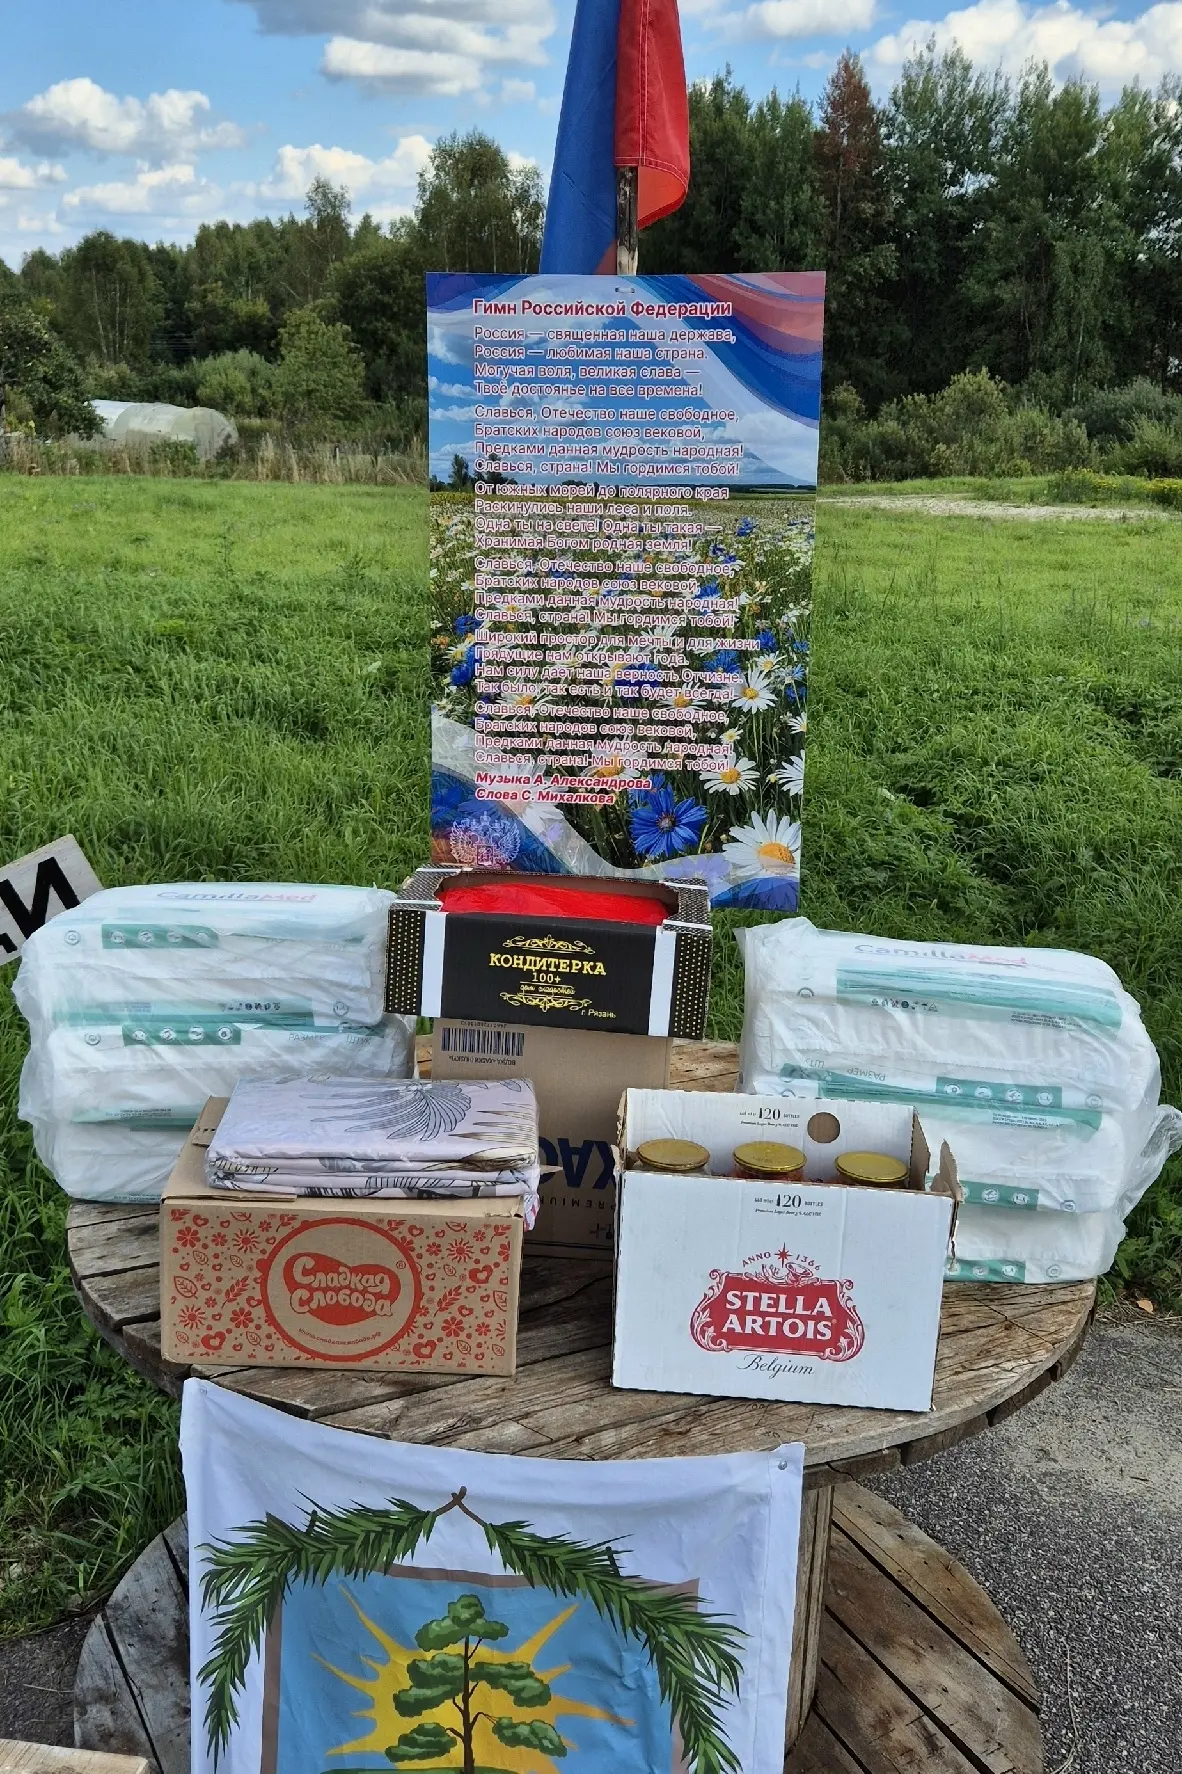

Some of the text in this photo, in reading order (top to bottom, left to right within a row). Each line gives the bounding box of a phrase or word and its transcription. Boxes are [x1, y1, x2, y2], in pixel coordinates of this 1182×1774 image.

[474, 300, 731, 318] Гимн Российской Федерации
[475, 327, 736, 342] Россия священная наша держава,
[475, 345, 707, 361] Россия любимая наша страна.
[475, 364, 680, 379] Могучая воля, великая слава
[476, 380, 702, 399] Твоё достоянье на все времена!
[476, 405, 739, 422] Славься, Отечество наше свободное,
[476, 424, 705, 440] Братских народов союз вековой,
[476, 442, 743, 459] Предками данная мудрость народная!
[476, 460, 739, 476] Славься, страна! Мы гордимся тобой!
[476, 482, 728, 499] От южных морей до полярного края
[476, 499, 692, 516] Раскинулись наши леса и поля.
[476, 518, 703, 533] Одна ты на свете! Одна ты такая
[477, 535, 692, 551] Хранимая Богом родная земля!
[476, 557, 734, 577] Славься, Отечество наше свободное,
[476, 575, 538, 588] Братских
[541, 578, 598, 590] народов
[602, 580, 637, 589] союз
[476, 592, 738, 611] Предками данная мудрость народная!
[476, 609, 734, 627] Славься, страна! Мы гордимся тобой!
[476, 630, 760, 649] Широкий простор для мечты и для жизни
[476, 647, 689, 666] Грядущие нам открывают года.
[476, 665, 504, 676] Нам
[507, 667, 538, 679] силу
[578, 668, 611, 679] наша
[616, 670, 678, 682] верность
[682, 671, 743, 682] Отчизне.
[476, 680, 499, 692] Так
[544, 683, 565, 693] так
[569, 685, 599, 694] есть
[604, 686, 612, 695] и
[617, 686, 638, 697] так
[641, 686, 680, 699] будет
[685, 688, 734, 699] всегда!
[476, 702, 730, 724] Славься, Отечество наше свободное,
[476, 718, 697, 739] Братских народов союз вековой,
[476, 735, 733, 754] Предками данная мудрость народная!
[476, 752, 729, 770] Славься, страна! Мы гордимся тобой!
[477, 773, 651, 789] Музыка А. Александрова
[477, 789, 613, 803] Слова С. Михалкова
[489, 953, 606, 975] КОНДИТЕРКА
[532, 972, 561, 983] 100+
[588, 1009, 616, 1019] Рязань
[847, 1068, 885, 1082] РАЗМЕР
[742, 1252, 821, 1271] ANNO 1366
[293, 1255, 389, 1294] Сладкая
[290, 1288, 393, 1317] Слобода
[725, 1290, 833, 1317] STELLA
[721, 1315, 833, 1340] ARTOIS
[737, 1354, 814, 1379] Belgium
